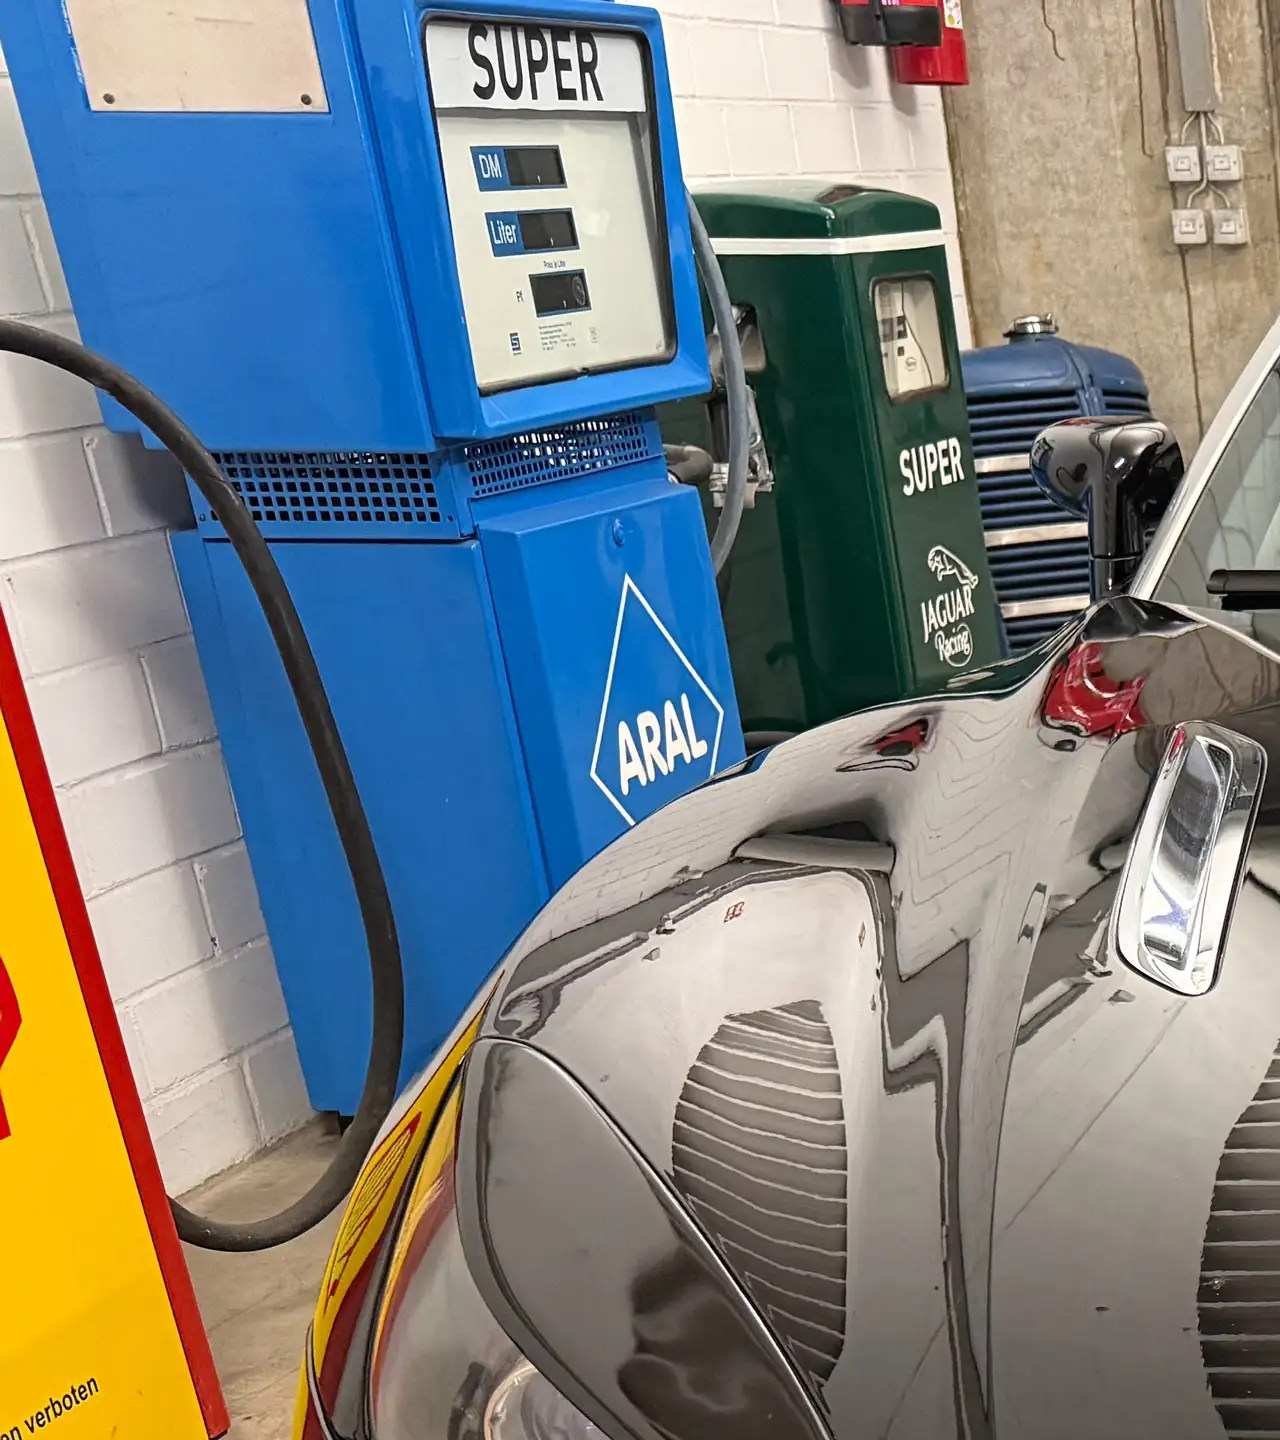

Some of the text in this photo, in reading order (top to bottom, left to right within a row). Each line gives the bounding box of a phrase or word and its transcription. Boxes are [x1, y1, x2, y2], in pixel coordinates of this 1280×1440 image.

[468, 23, 604, 101] SUPER
[479, 153, 502, 178] DM
[490, 220, 517, 245] Liter
[900, 437, 965, 496] SUPER
[921, 585, 975, 643] JAGUAR
[935, 622, 973, 668] Racing
[618, 692, 708, 796] ARAL
[24, 1377, 99, 1434] verboten
